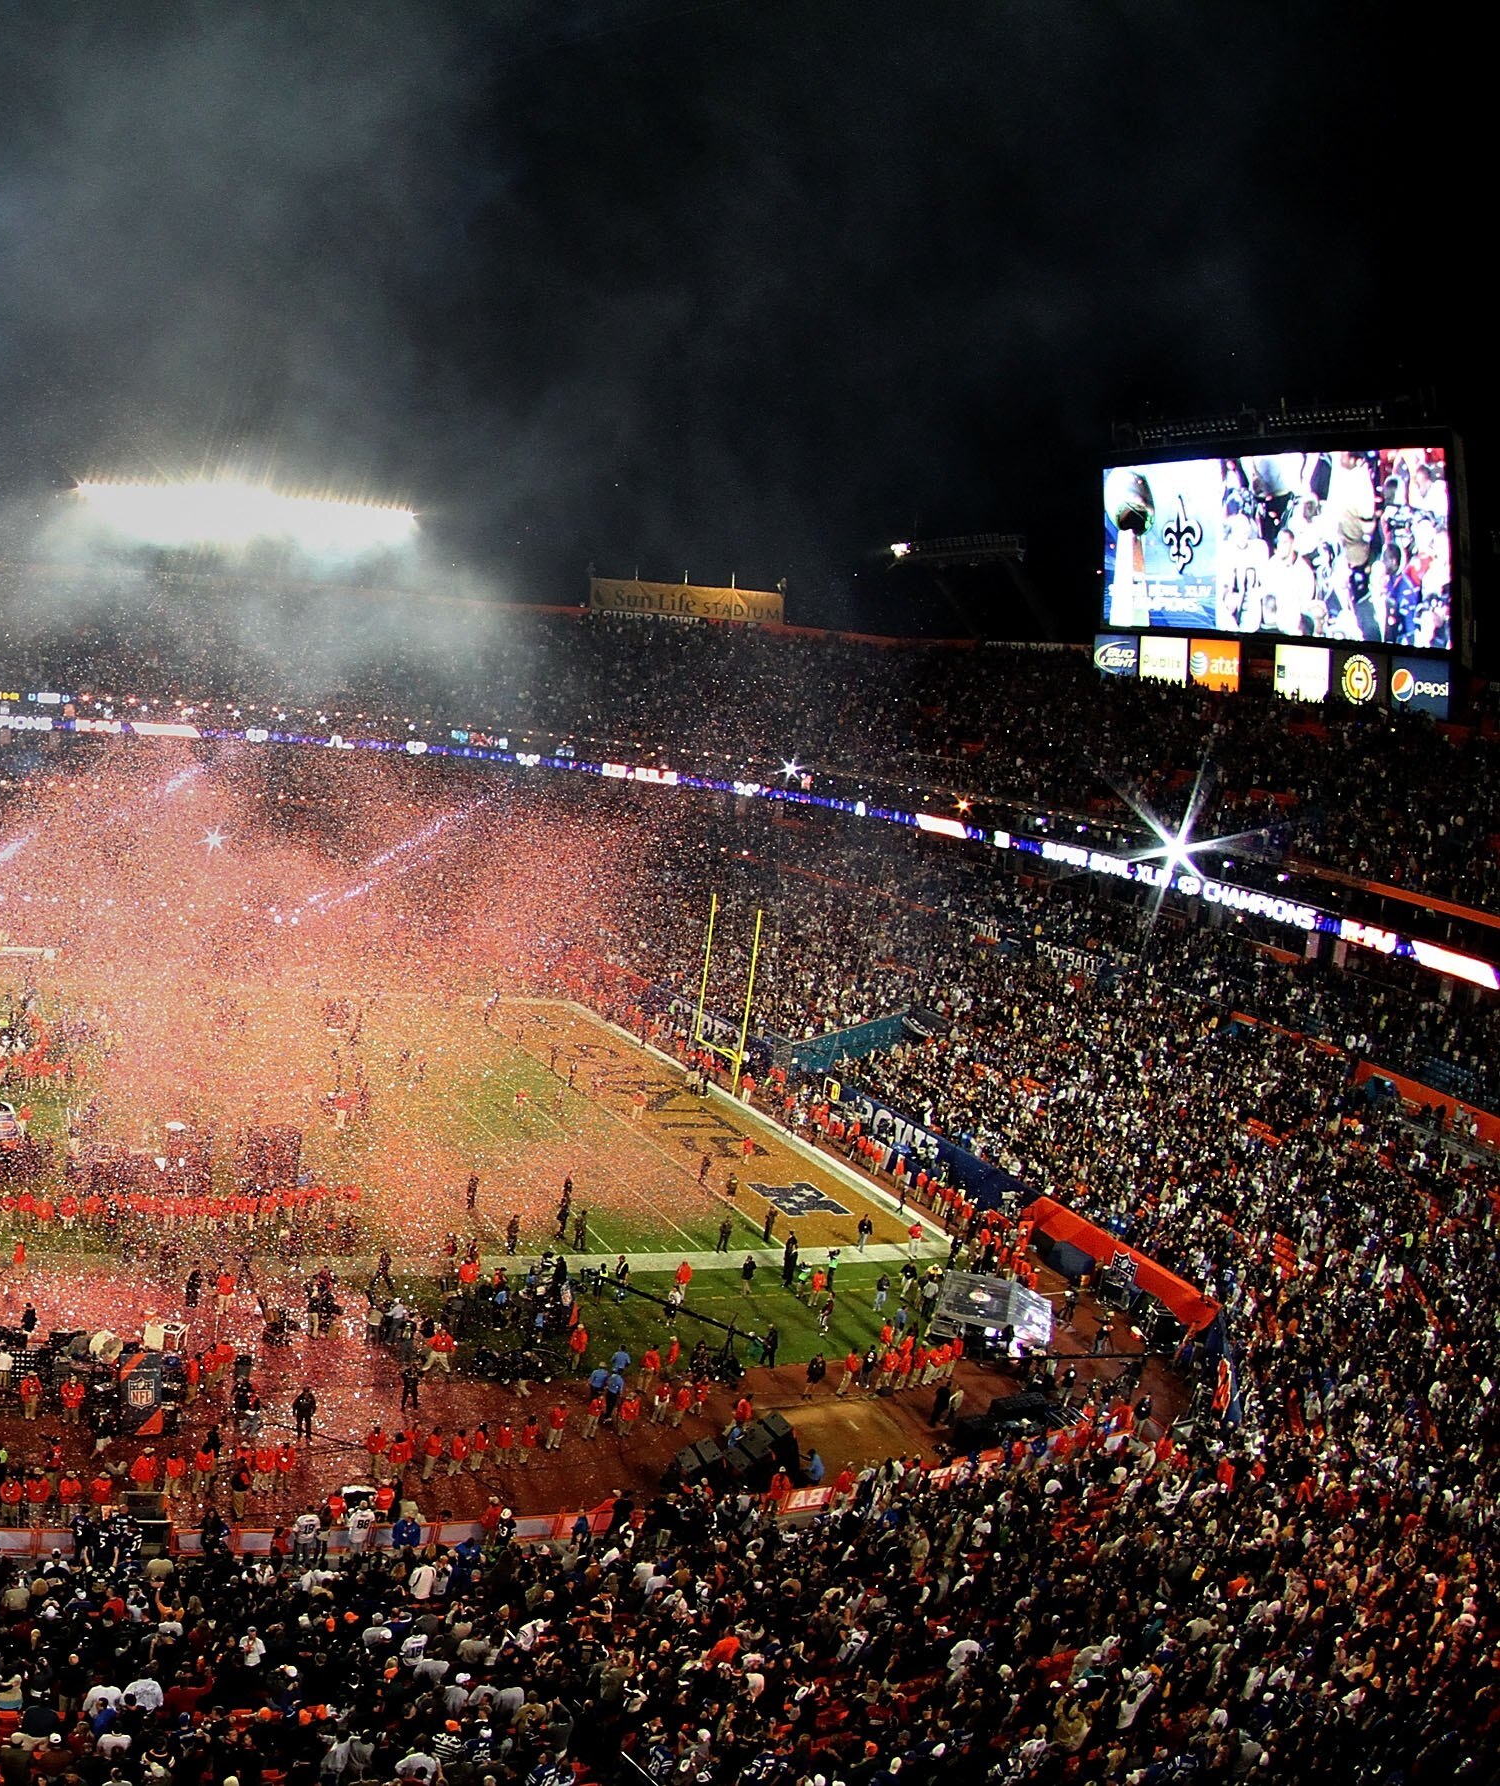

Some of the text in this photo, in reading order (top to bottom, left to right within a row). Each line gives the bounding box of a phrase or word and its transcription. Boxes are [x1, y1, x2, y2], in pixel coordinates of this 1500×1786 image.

[614, 589, 781, 620] Sun Life STADIUM
[1100, 655, 1138, 668] LIGHT
[1106, 647, 1136, 659] BUD
[1209, 656, 1240, 676] at&t
[1413, 680, 1450, 698] pepsi
[1203, 881, 1317, 931] CHAMPIONS
[1035, 940, 1098, 976] FOOTBALL
[132, 1391, 152, 1405] NFL
[357, 1519, 370, 1530] 88
